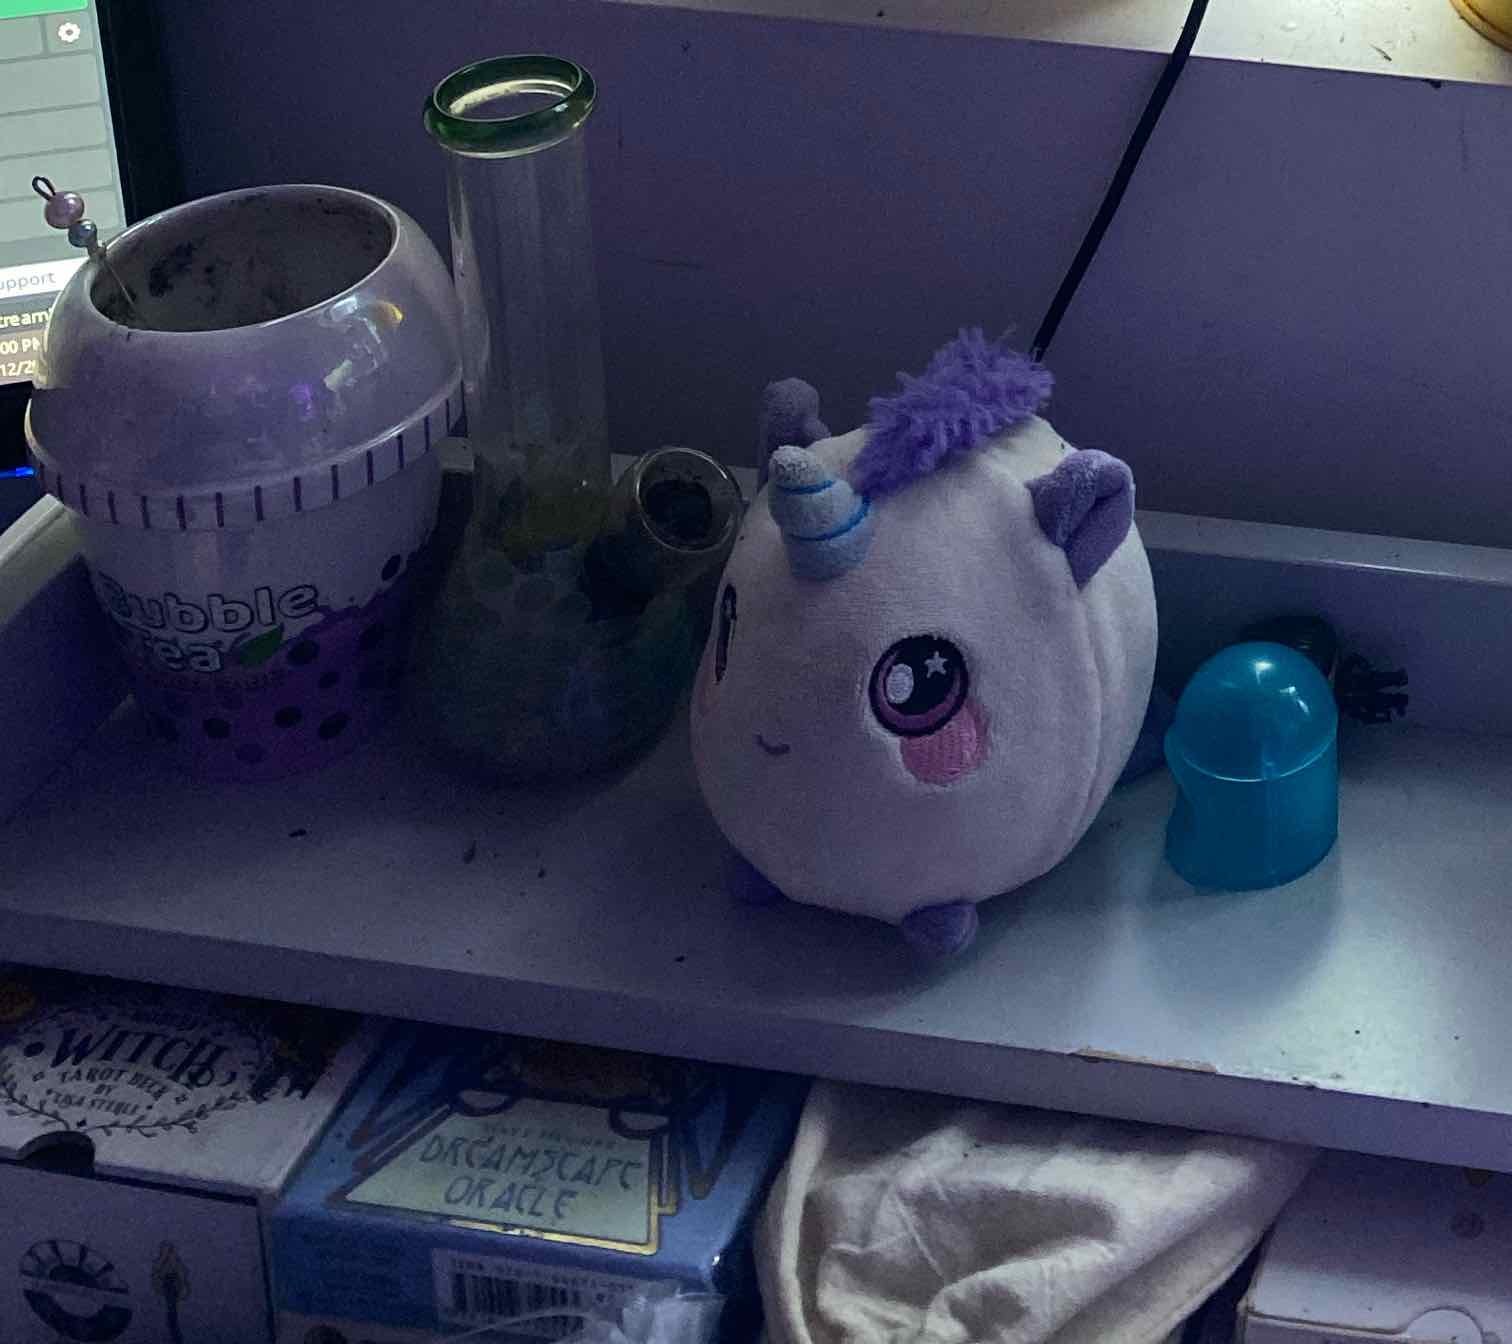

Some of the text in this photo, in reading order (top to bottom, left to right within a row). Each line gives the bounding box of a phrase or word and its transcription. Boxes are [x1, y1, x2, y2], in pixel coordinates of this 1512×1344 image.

[95, 570, 319, 634] Bubble
[50, 1023, 228, 1087] WITCH
[60, 1069, 127, 1084] TAROT
[419, 1135, 643, 1189] DREAMSCAPE
[444, 1174, 578, 1219] ORACLE
